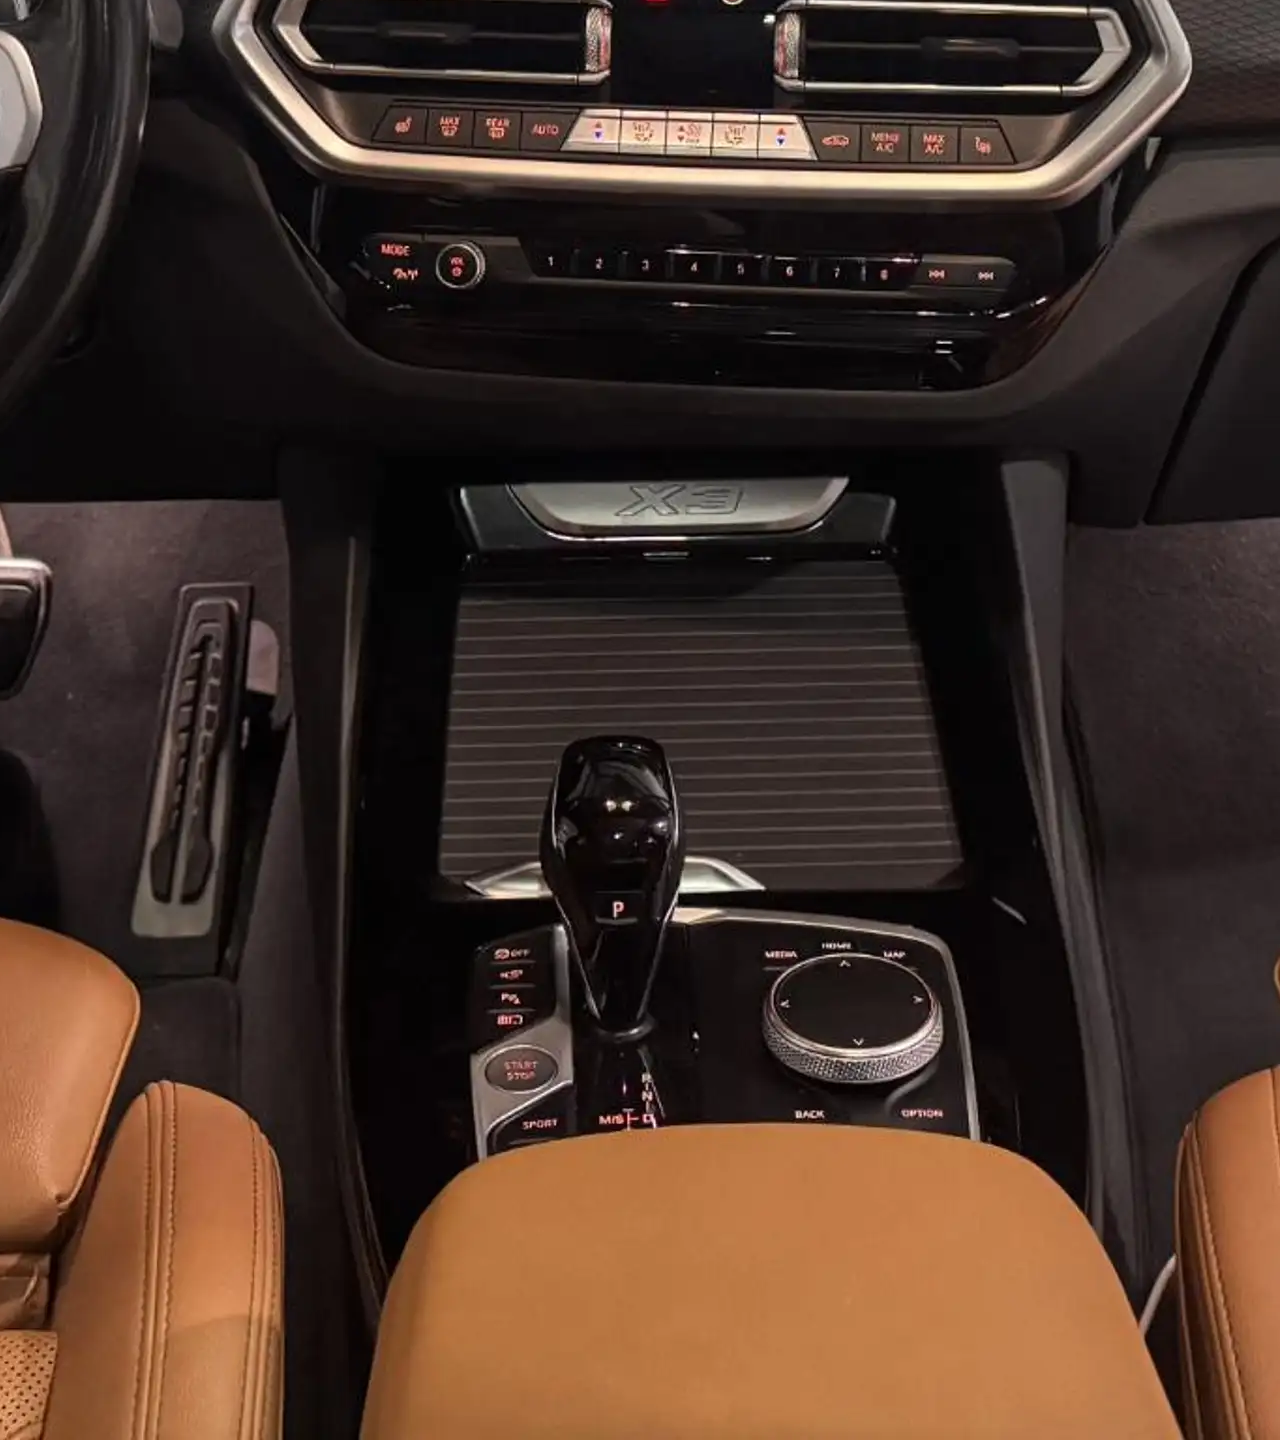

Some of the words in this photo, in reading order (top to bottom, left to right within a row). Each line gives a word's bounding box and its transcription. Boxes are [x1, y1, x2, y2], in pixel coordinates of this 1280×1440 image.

[531, 123, 559, 136] AUTO
[923, 133, 946, 144] MAX
[381, 244, 412, 257] MODE
[548, 256, 554, 267] 1
[596, 258, 603, 270] 2
[642, 260, 650, 272] 3
[690, 262, 698, 273] 4
[737, 263, 745, 276] 5
[786, 266, 794, 277] 6
[615, 483, 744, 517] X3
[612, 901, 625, 919] P
[822, 941, 852, 950] HOME
[765, 950, 797, 959] MEDIA
[884, 950, 906, 959] MAP
[504, 1061, 538, 1071] START
[507, 1071, 536, 1080] STOP
[642, 1092, 653, 1101] N
[795, 1110, 825, 1119] BACK
[901, 1109, 943, 1118] OPTION
[523, 1117, 558, 1129] SPORT
